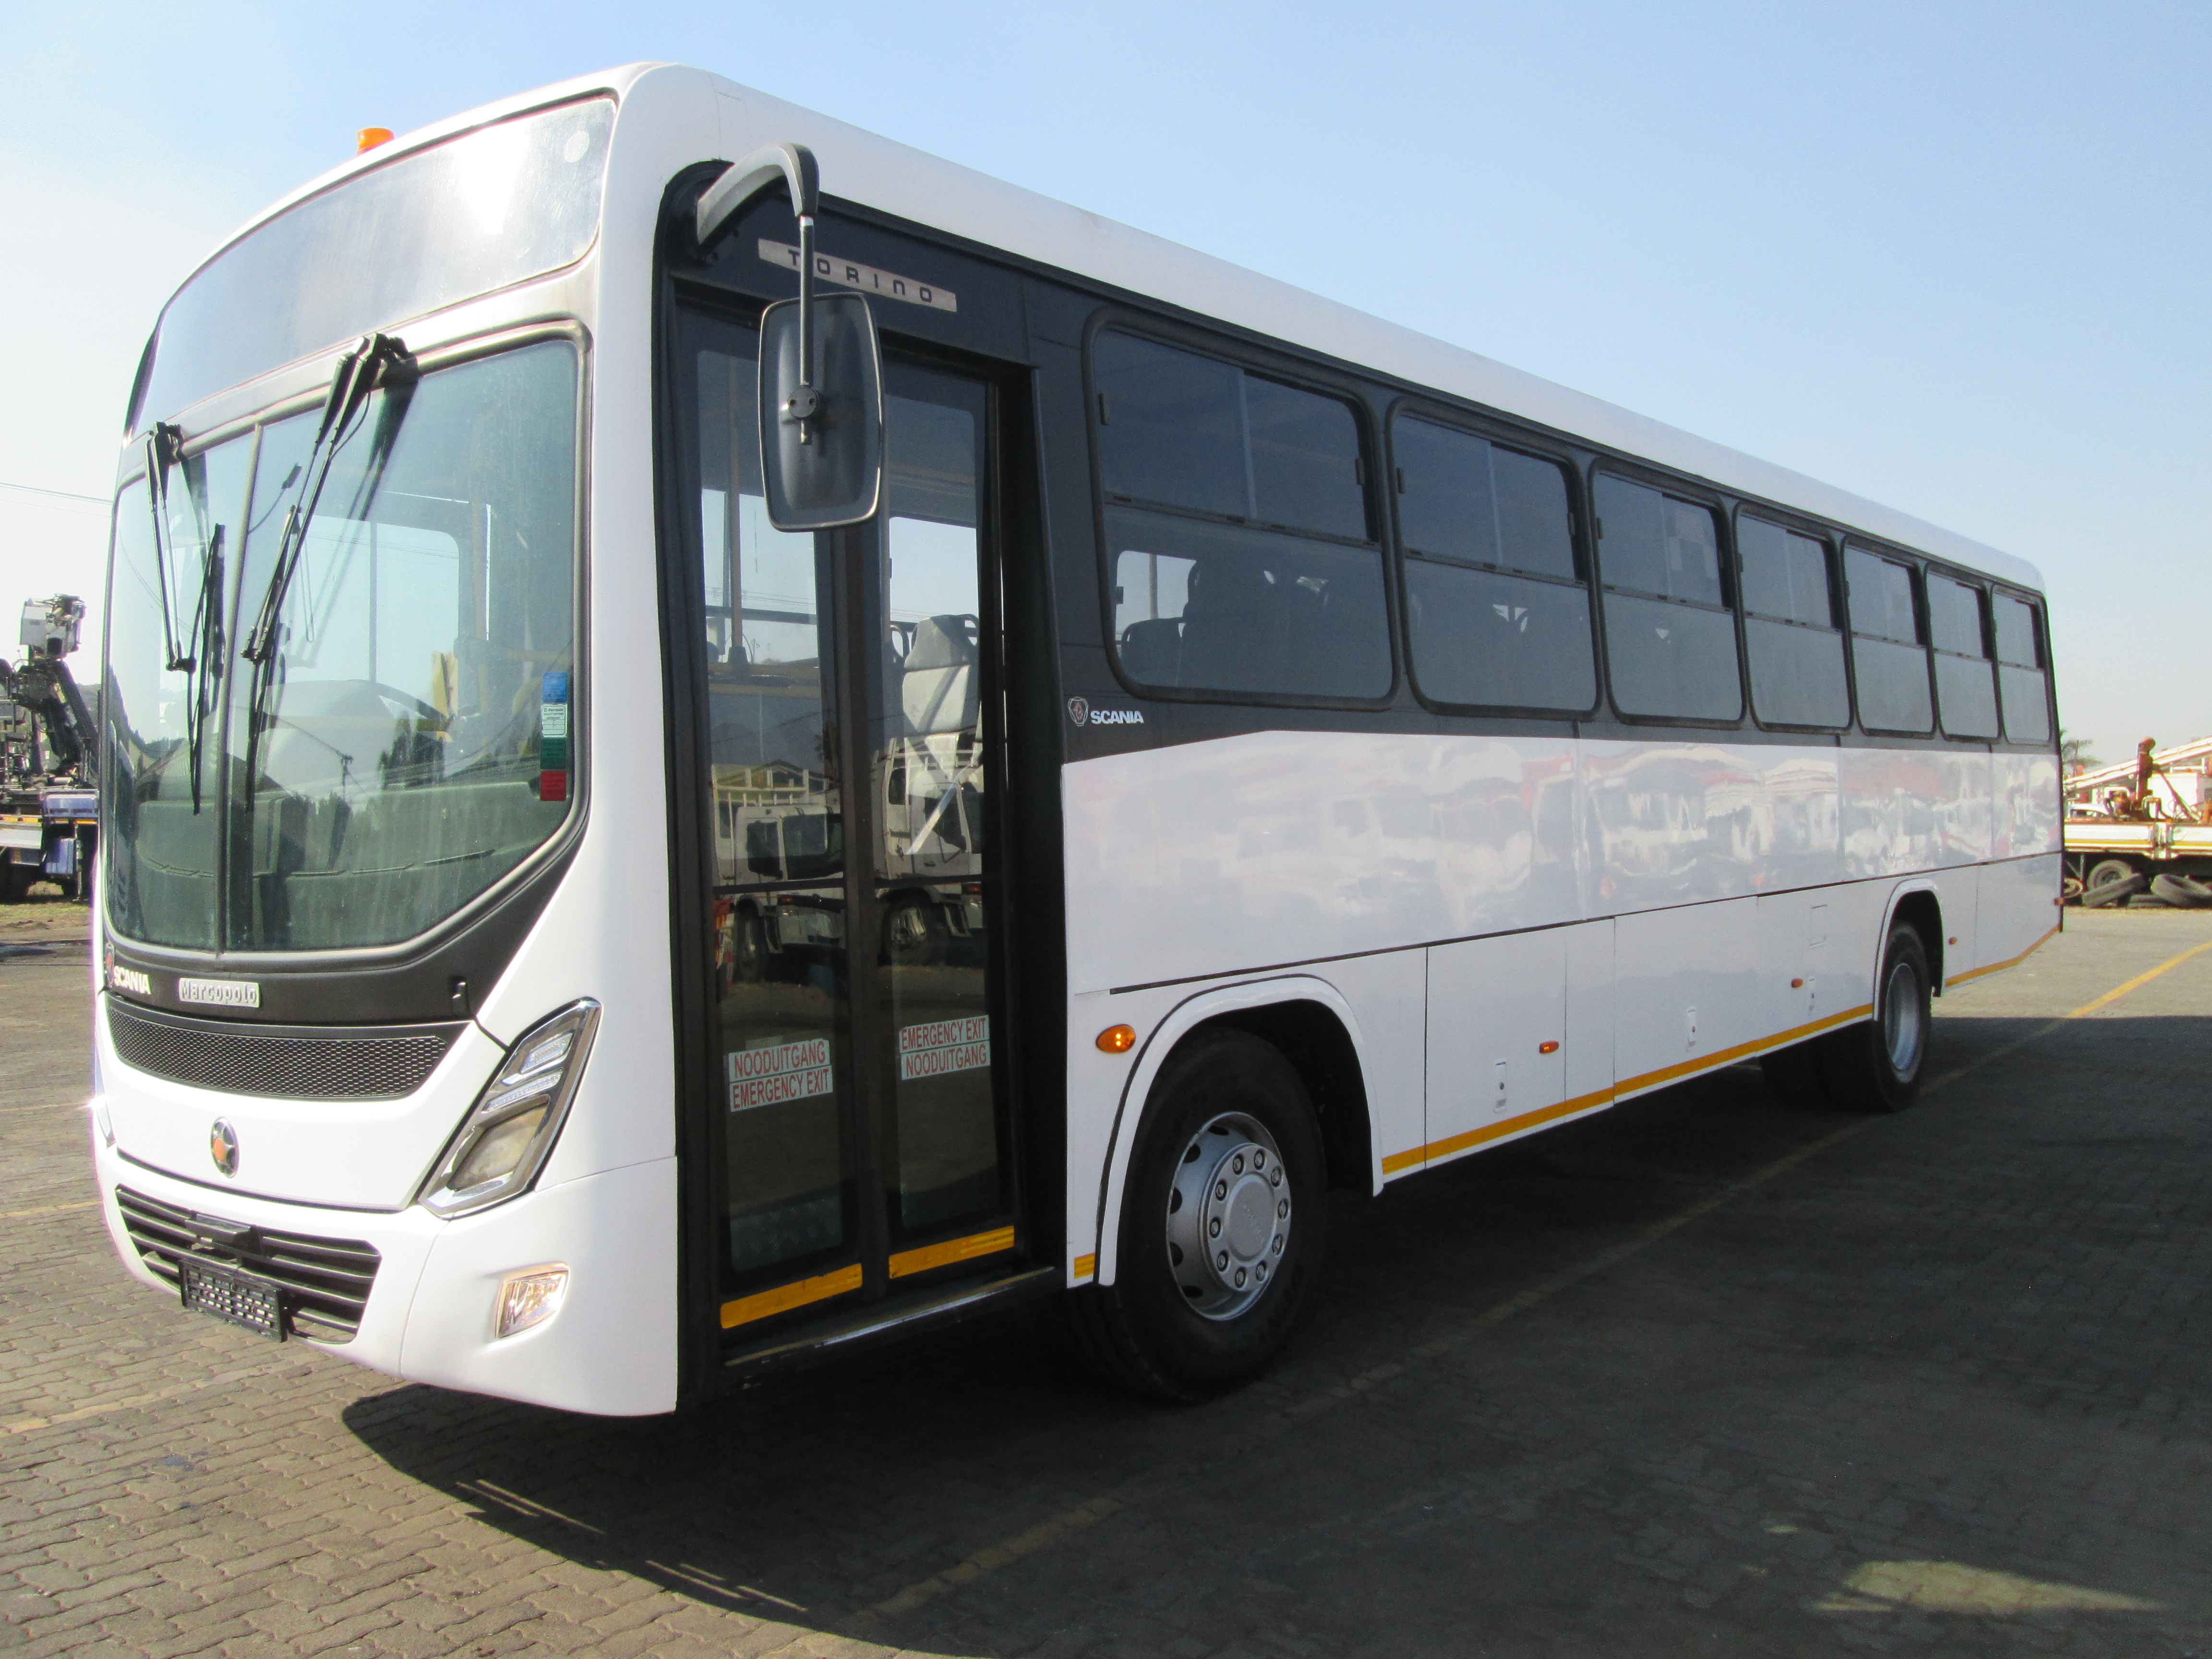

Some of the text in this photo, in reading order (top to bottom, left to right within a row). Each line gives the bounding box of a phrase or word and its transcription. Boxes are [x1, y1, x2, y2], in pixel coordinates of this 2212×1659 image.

[1090, 710, 1144, 724] SCANIA
[113, 965, 152, 995] SCANIA
[181, 979, 257, 1004] Marcopolo
[902, 1018, 986, 1050] EMERGENCY EXIT
[734, 1041, 826, 1079] NOODUITGANG
[906, 1044, 986, 1077] NOODUITGANG
[733, 1069, 829, 1109] EMERGENCY EXIT
